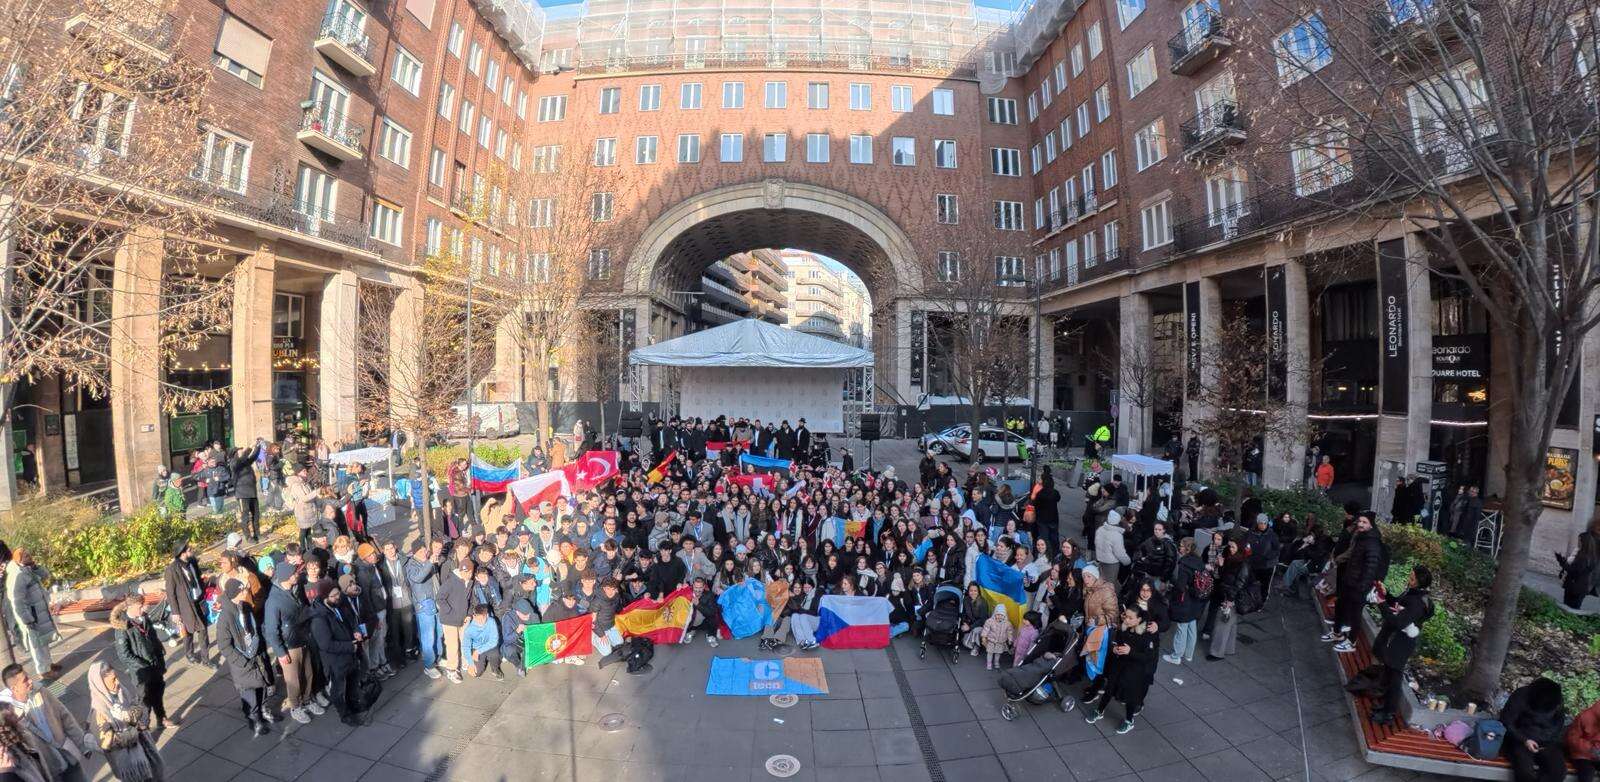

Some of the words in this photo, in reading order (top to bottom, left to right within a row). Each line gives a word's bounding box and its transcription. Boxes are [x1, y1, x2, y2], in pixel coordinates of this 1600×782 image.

[1388, 295, 1397, 357] LEONARDO
[1432, 345, 1471, 354] eonardo
[1456, 369, 1481, 378] HOTEL
